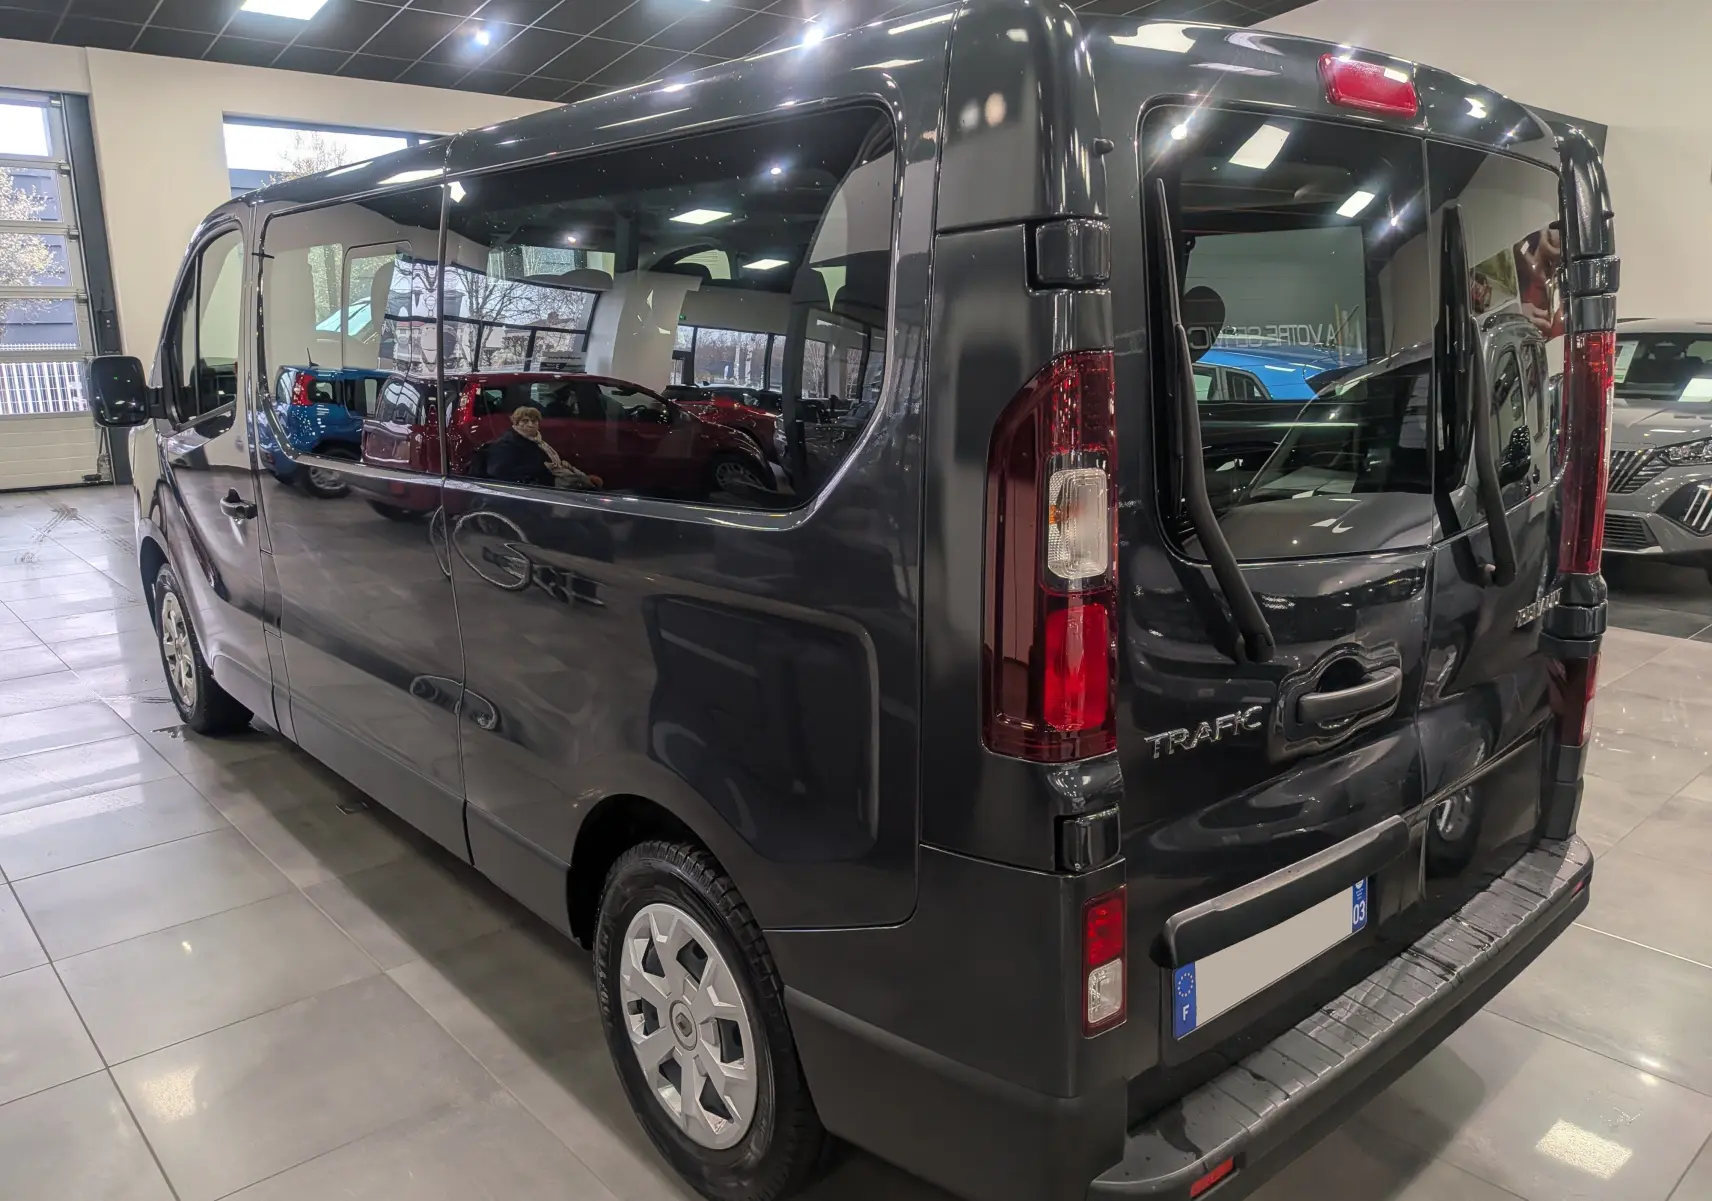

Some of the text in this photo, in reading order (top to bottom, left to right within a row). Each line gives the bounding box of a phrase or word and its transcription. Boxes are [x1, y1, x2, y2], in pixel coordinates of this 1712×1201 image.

[1143, 705, 1263, 759] TRAFIC
[1353, 899, 1366, 925] 03
[1182, 1004, 1190, 1021] F
